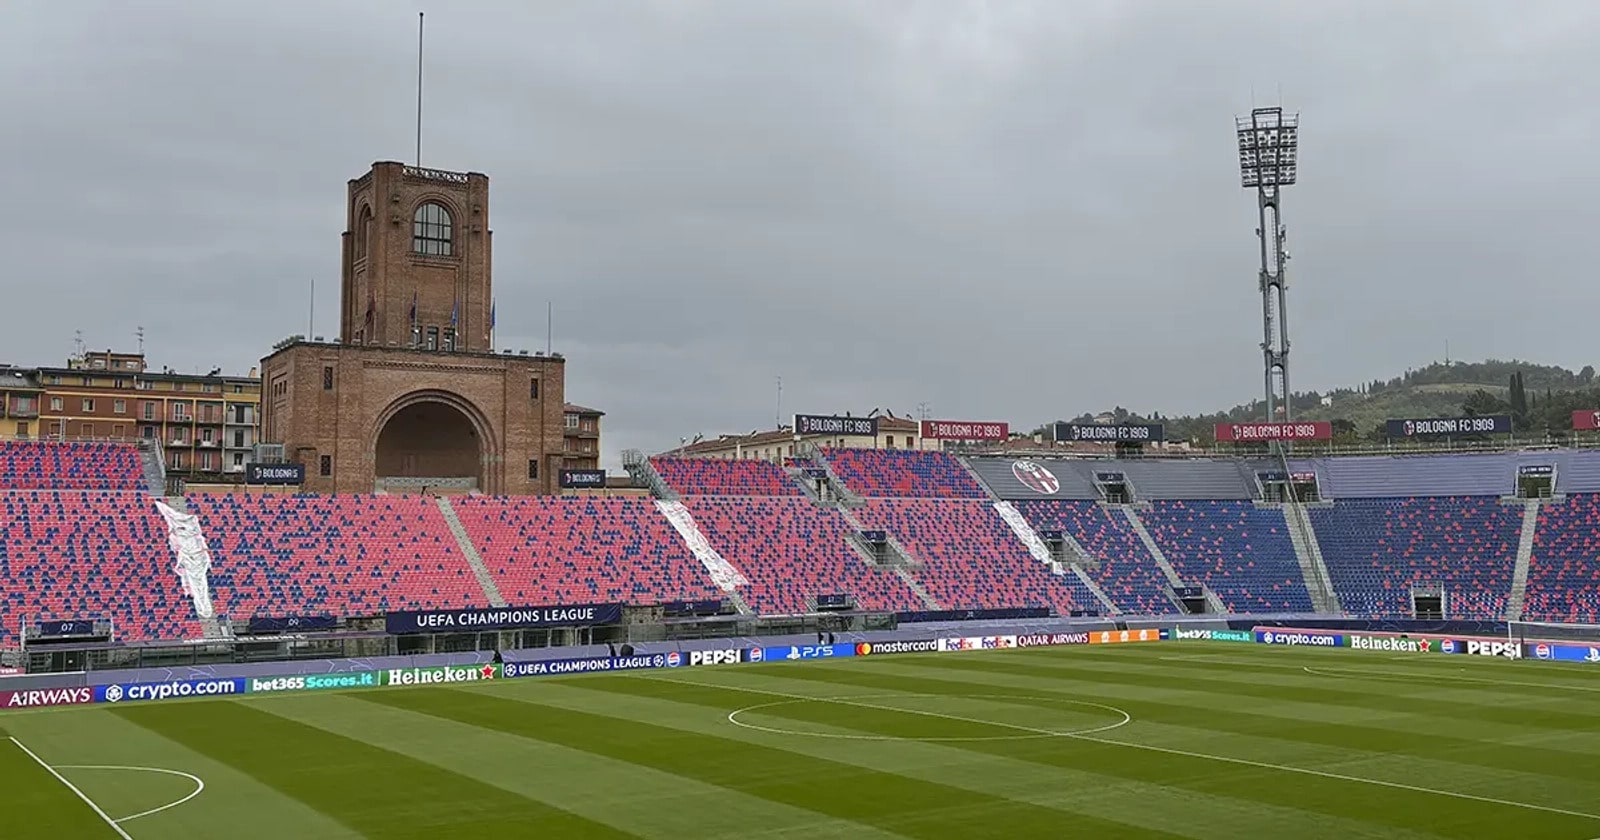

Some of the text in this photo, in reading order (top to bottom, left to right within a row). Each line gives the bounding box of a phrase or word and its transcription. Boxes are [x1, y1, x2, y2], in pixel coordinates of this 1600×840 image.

[810, 419, 871, 433] BOLOGNA FC 1909
[939, 424, 1001, 437] BOLOGNA FC 1909
[1081, 427, 1149, 438] BOLOGNA FC 1909
[1242, 425, 1315, 438] BOLOGNA FC 1909
[1416, 418, 1494, 433] BOLOGNA FC 1909
[417, 608, 594, 627] UEFA CHAMPIONS LEAGUE
[61, 623, 74, 632] 07
[981, 636, 1008, 650] FedEx
[1018, 632, 1088, 648] QATAR AIRWAYS
[1212, 631, 1250, 641] Scores.it
[1275, 633, 1335, 646] crypto.com
[873, 640, 937, 653] mastercard
[946, 638, 974, 651] FedEx
[1350, 635, 1418, 652] Heineken
[1467, 641, 1522, 658] PEPSI
[690, 649, 741, 666] PEPSI
[803, 646, 833, 657] PS5
[519, 656, 651, 675] UEFA CHAMPIONS LEAGUE
[252, 673, 373, 691] bet365 Scores.it
[388, 666, 478, 685] Heineken
[8, 687, 91, 706] AIRWAYS
[128, 680, 235, 700] crypto.com
